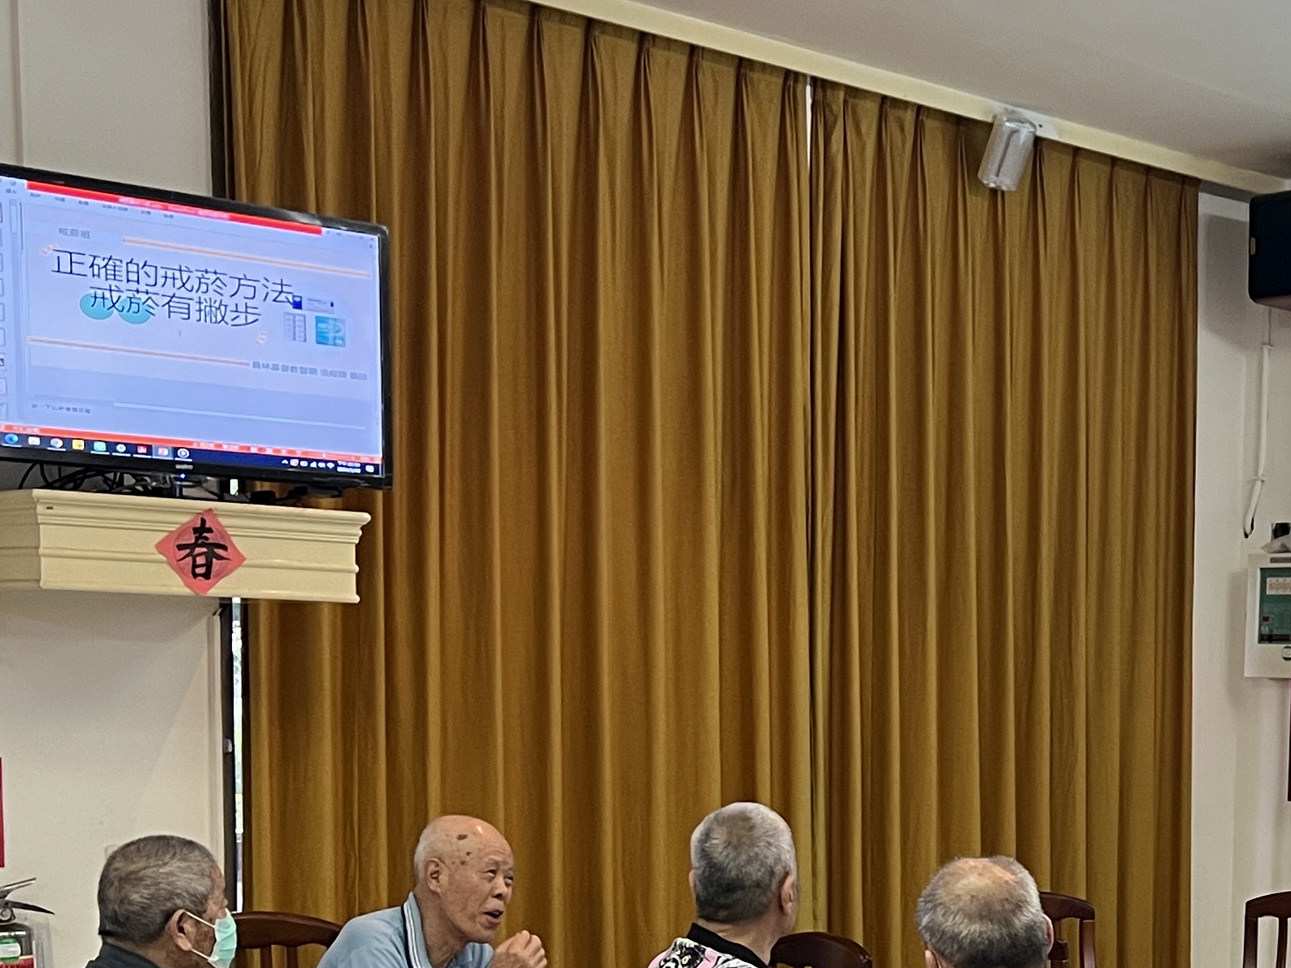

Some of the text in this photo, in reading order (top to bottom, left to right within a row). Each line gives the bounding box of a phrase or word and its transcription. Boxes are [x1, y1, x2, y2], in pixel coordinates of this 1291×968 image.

[51, 248, 294, 305] 正確的戒菸方法
[90, 286, 262, 327] 戒菸有撇步
[176, 518, 231, 582] 春
